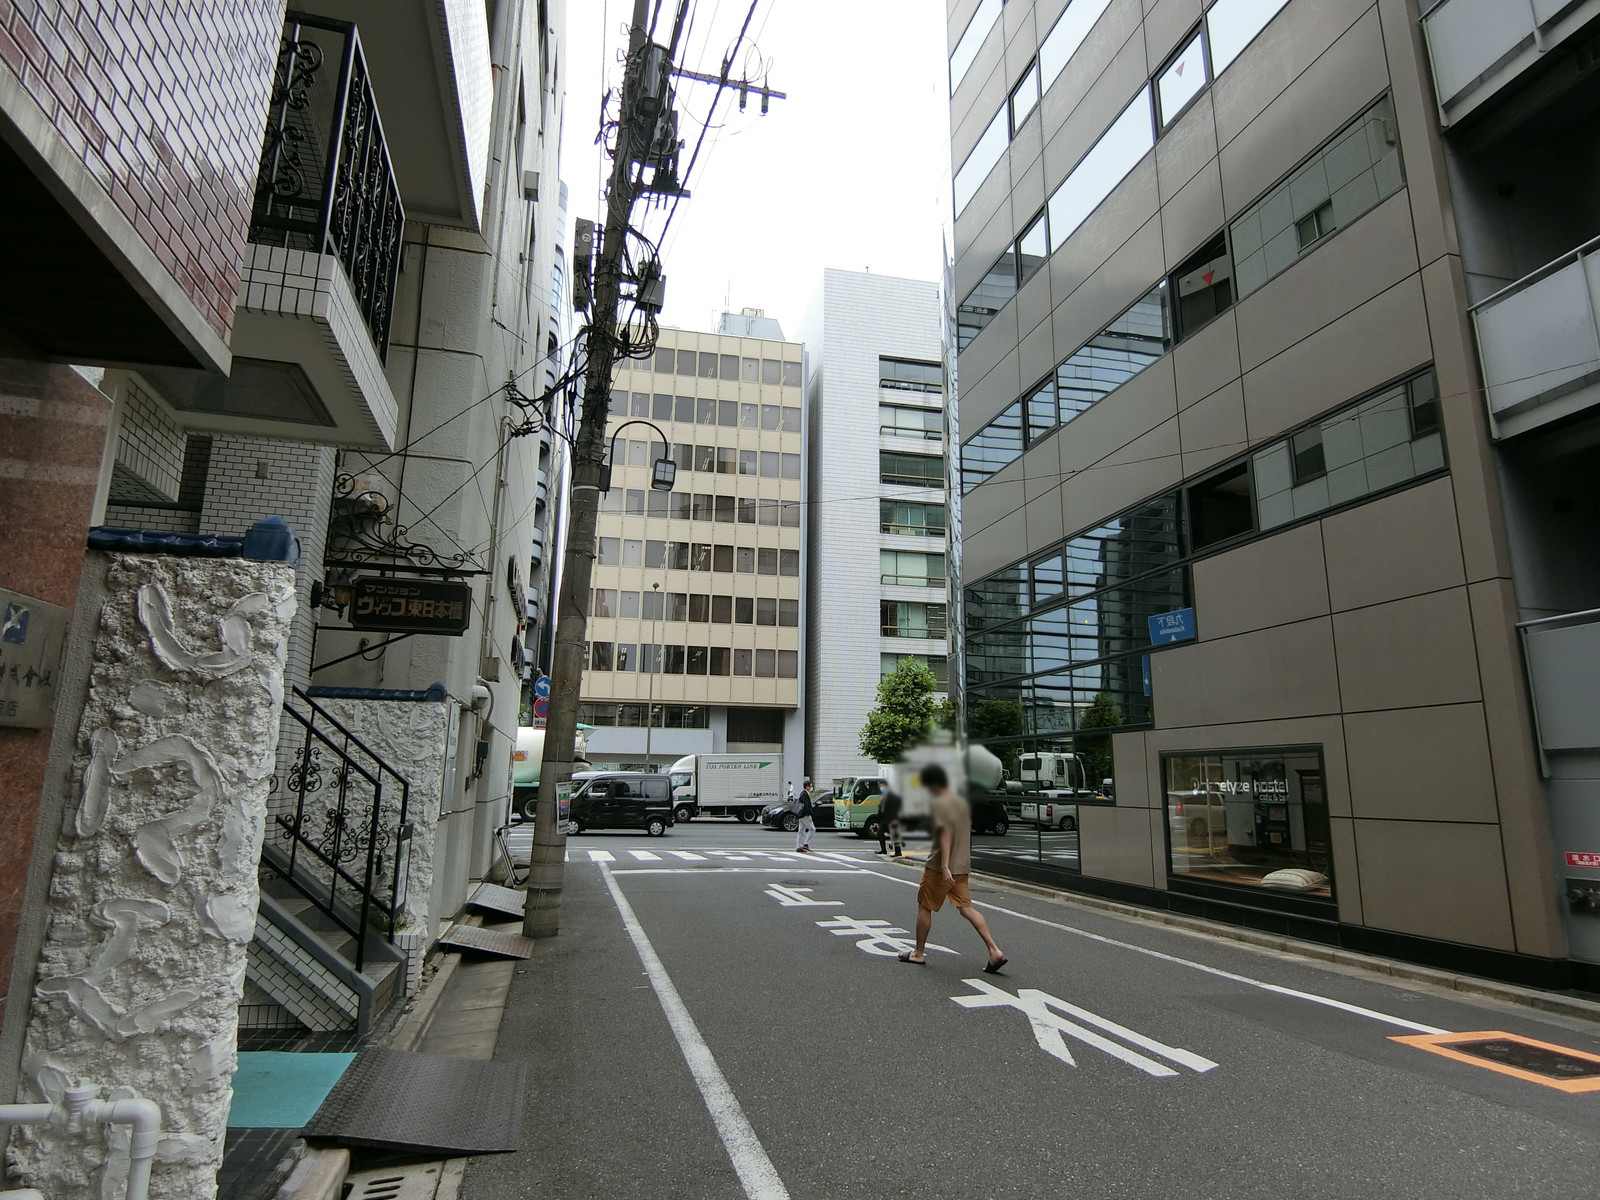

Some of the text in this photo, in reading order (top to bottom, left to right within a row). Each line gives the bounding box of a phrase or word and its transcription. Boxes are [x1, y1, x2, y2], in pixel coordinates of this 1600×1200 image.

[364, 584, 421, 596] マンション
[0, 662, 52, 688] 式會社
[1253, 778, 1289, 793] hostel
[764, 883, 1220, 1078] 止まれ
